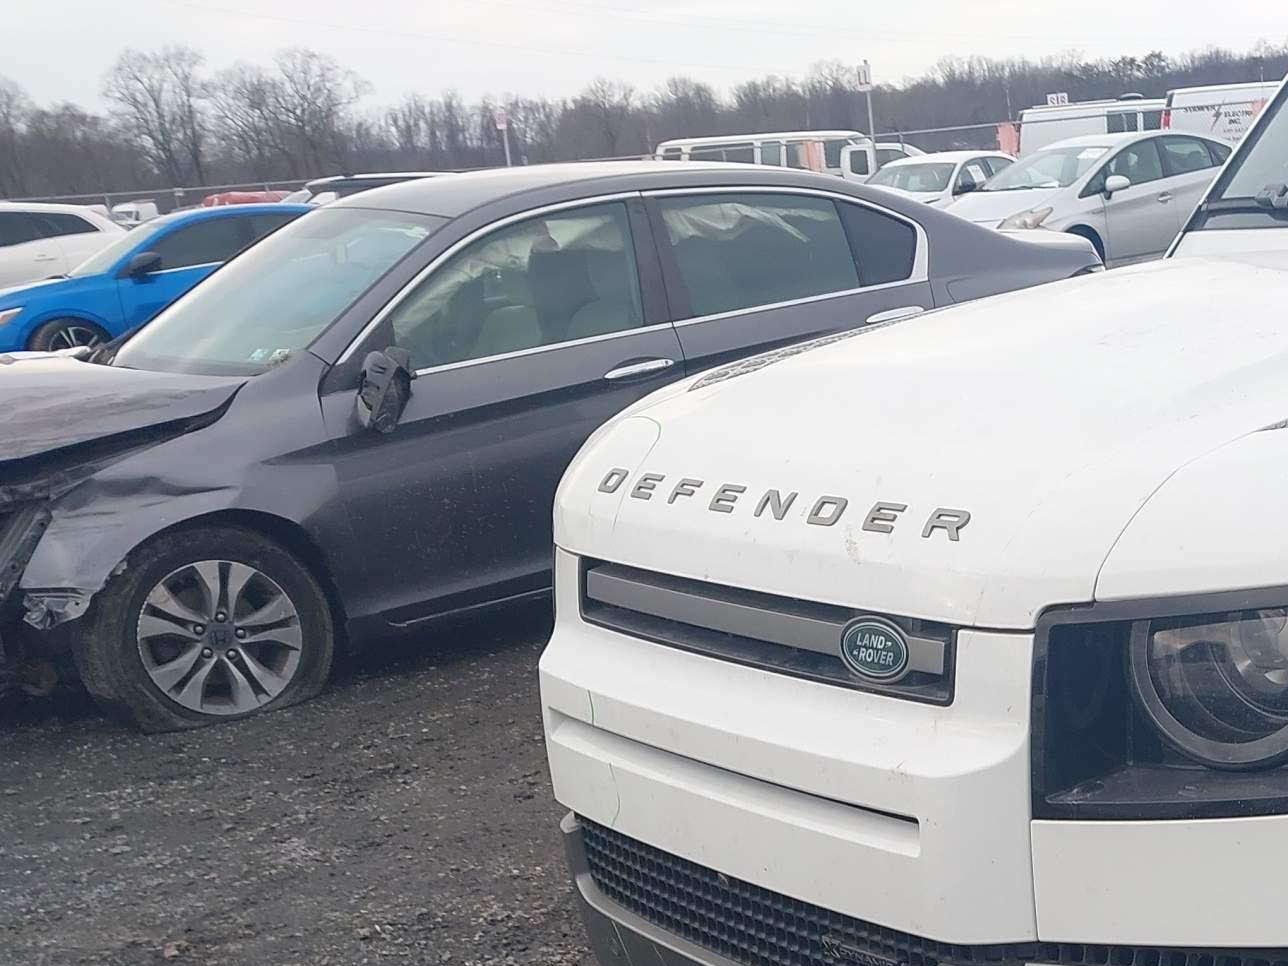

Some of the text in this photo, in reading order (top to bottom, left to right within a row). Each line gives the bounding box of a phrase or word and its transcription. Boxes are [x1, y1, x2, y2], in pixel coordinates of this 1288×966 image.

[598, 467, 971, 541] DEFENDER
[856, 632, 885, 649] LAND
[858, 647, 894, 666] ROVER
